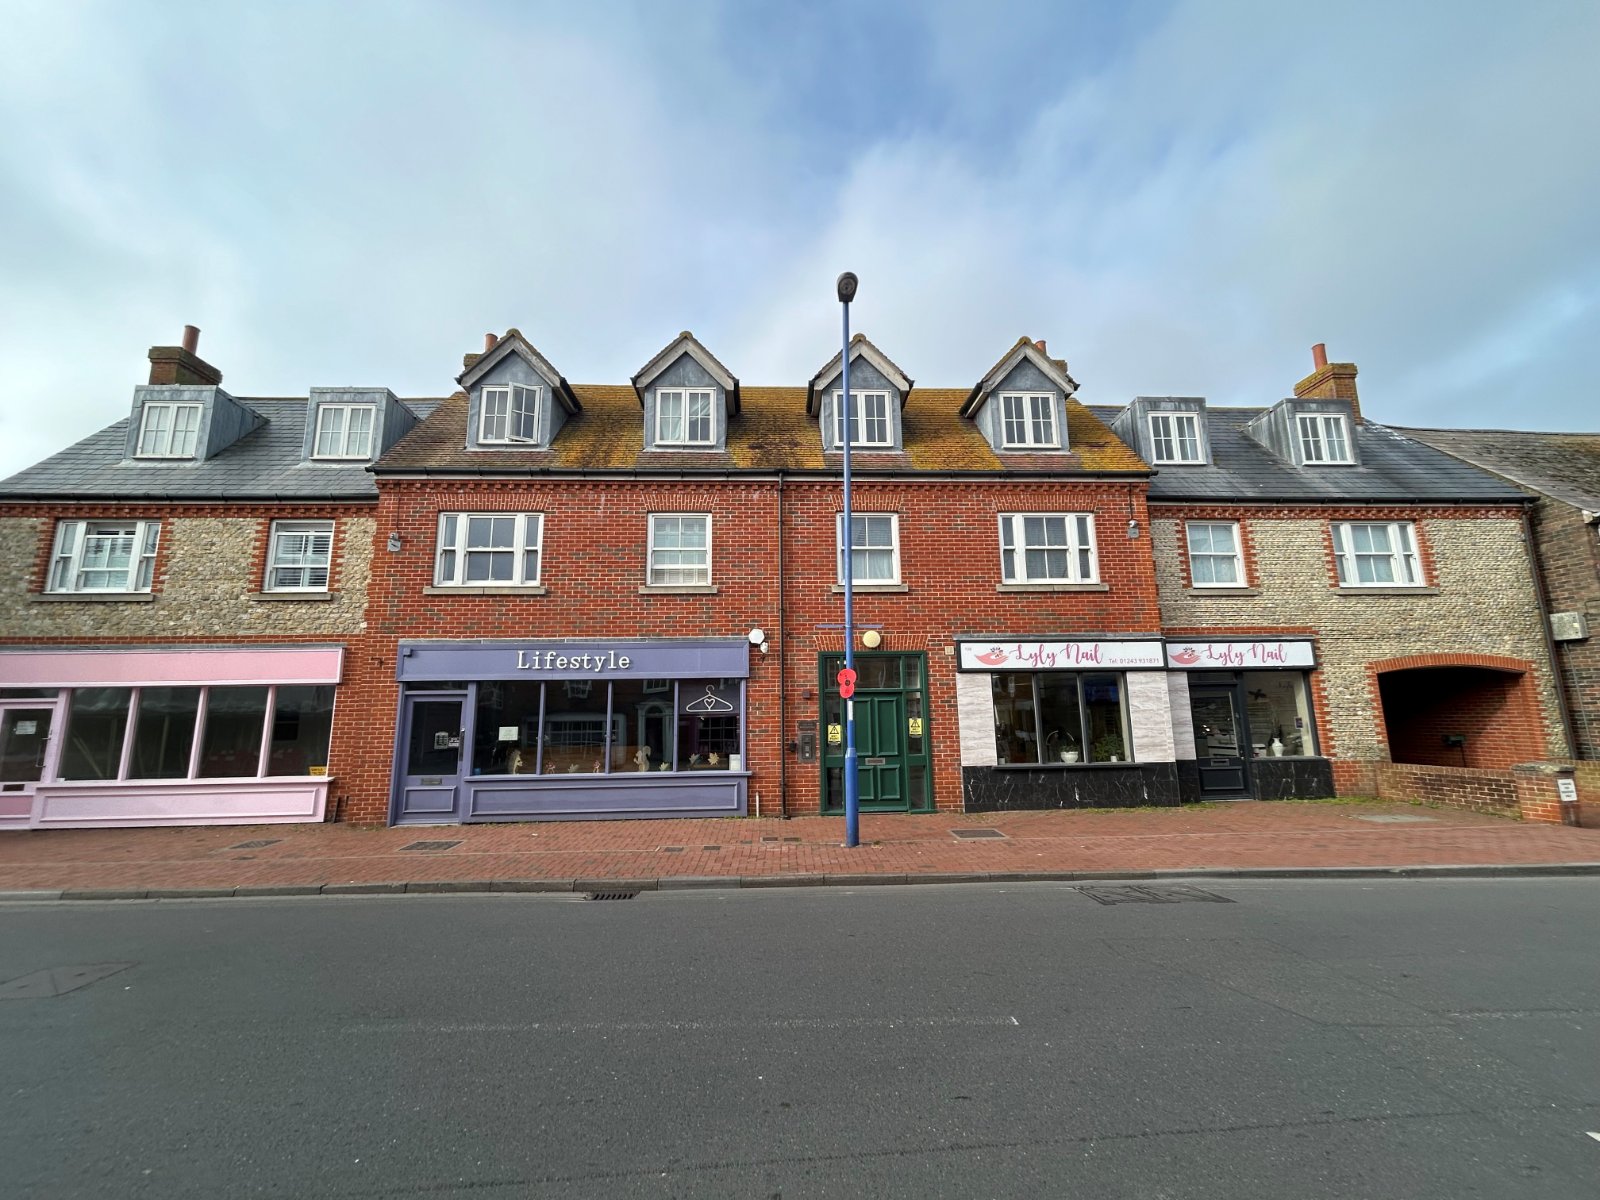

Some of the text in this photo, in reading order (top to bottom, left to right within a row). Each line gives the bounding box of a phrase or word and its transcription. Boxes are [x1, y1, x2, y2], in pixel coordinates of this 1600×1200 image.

[516, 650, 631, 673] Lifestyle
[1009, 643, 1103, 667] Lyly Nail
[1200, 643, 1288, 666] Lyly Nail
